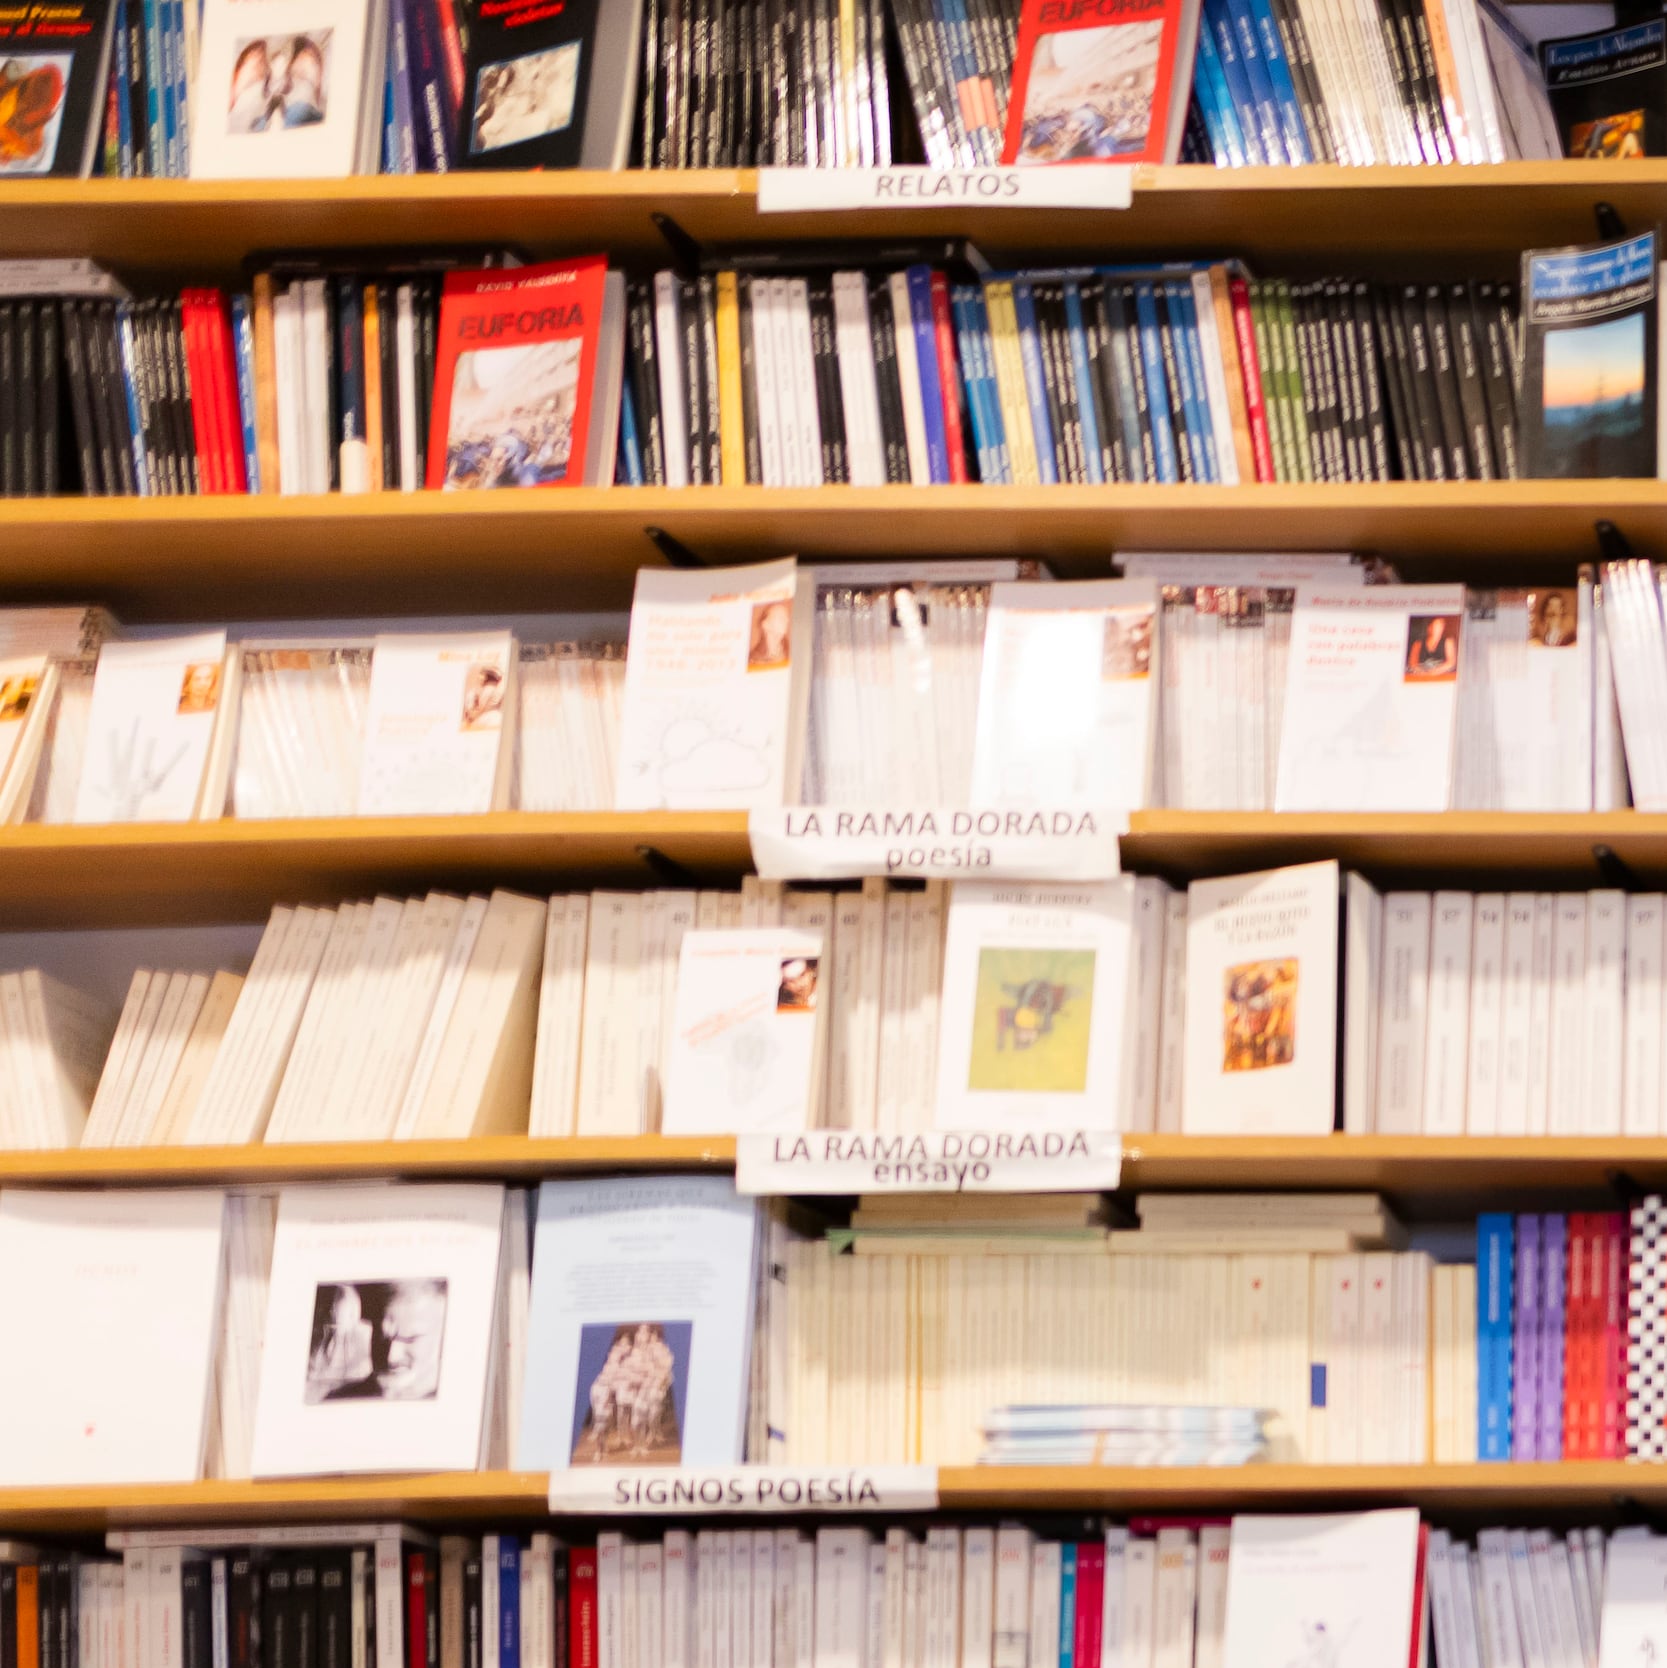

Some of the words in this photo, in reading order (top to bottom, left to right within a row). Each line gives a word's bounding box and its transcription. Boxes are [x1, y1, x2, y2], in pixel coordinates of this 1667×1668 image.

[875, 173, 1020, 198] RELATOS
[458, 303, 584, 340] EUFORIA
[786, 811, 824, 838] LA
[836, 811, 936, 838] RAMA
[954, 810, 1098, 838] DORADA
[887, 840, 994, 873] poesía
[774, 1136, 812, 1164] LA
[824, 1133, 928, 1163] RAMA
[941, 1131, 1089, 1162] DORADA
[874, 1160, 992, 1194] ensayo
[614, 1476, 744, 1505] SIGNOS
[757, 1471, 880, 1505] POESÍA
